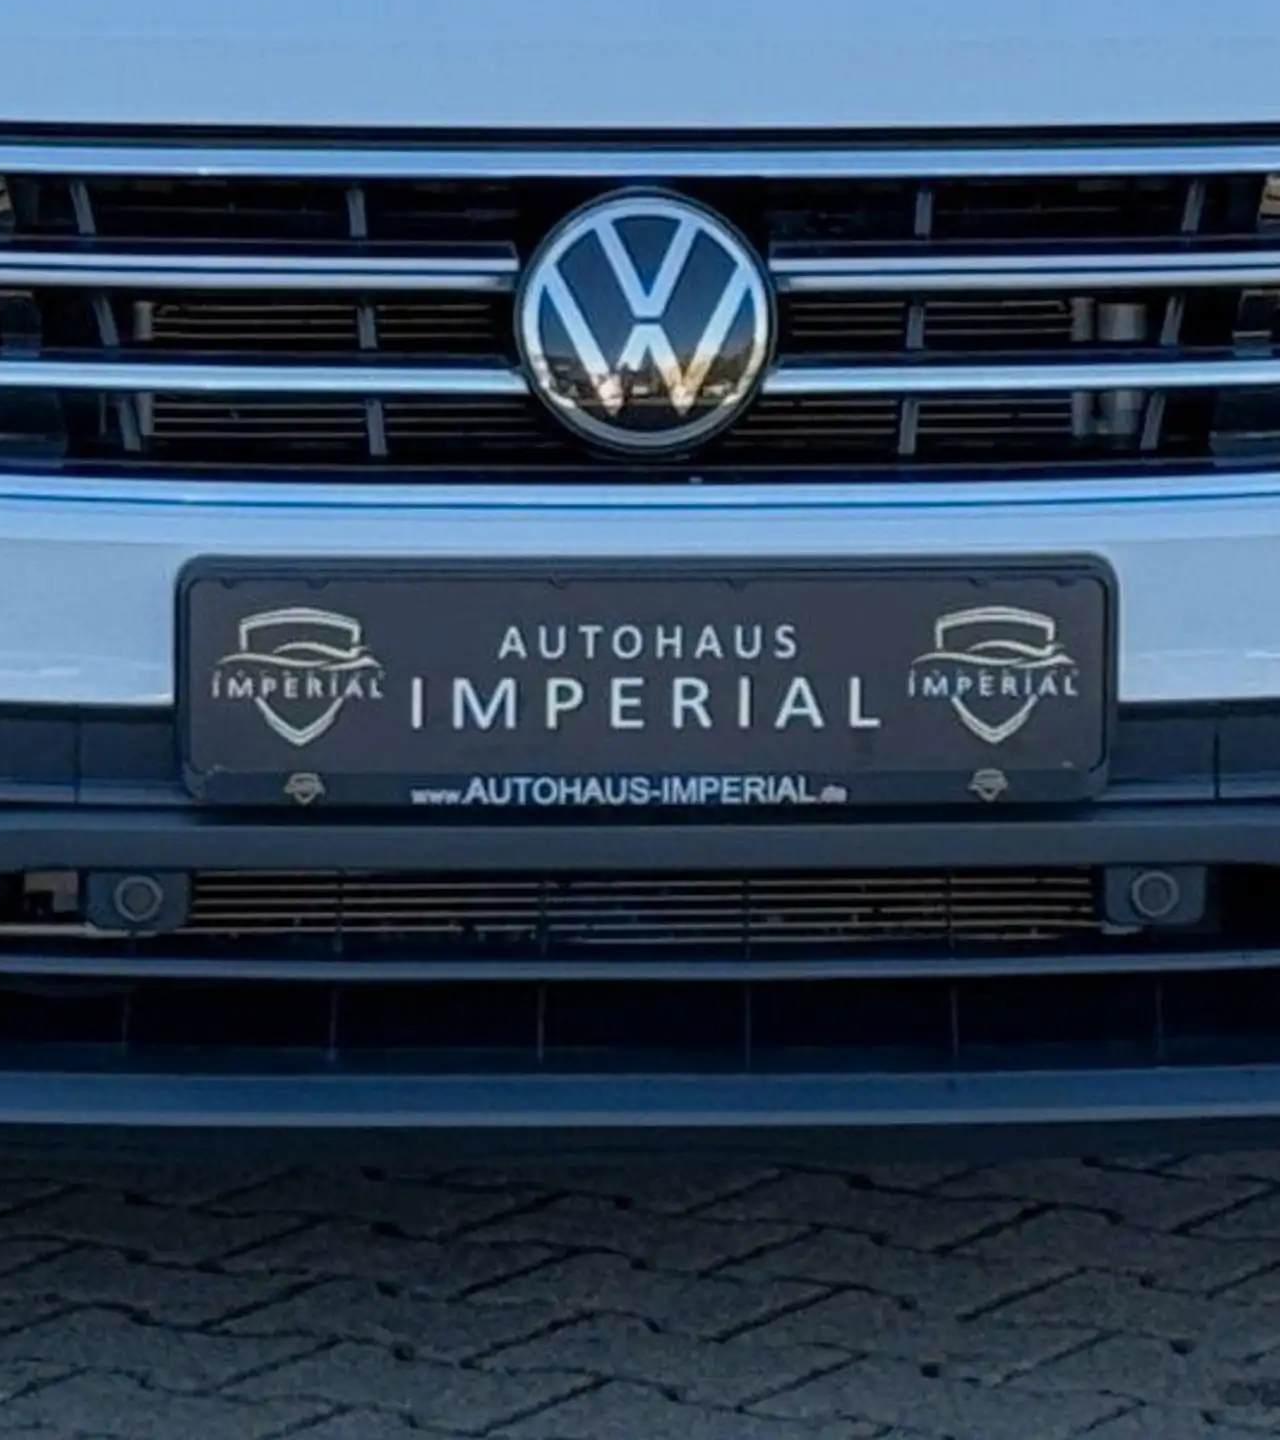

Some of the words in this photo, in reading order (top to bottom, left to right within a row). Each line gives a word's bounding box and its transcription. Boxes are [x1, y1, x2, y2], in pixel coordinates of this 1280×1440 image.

[497, 624, 799, 661] AUTOHAUS
[210, 674, 385, 700] IMPERIAL
[907, 672, 1081, 698] IMPERIAL
[410, 675, 882, 731] IMPERIAL
[409, 774, 849, 806] www.AUTOHAUS-IMPERIAL.de
